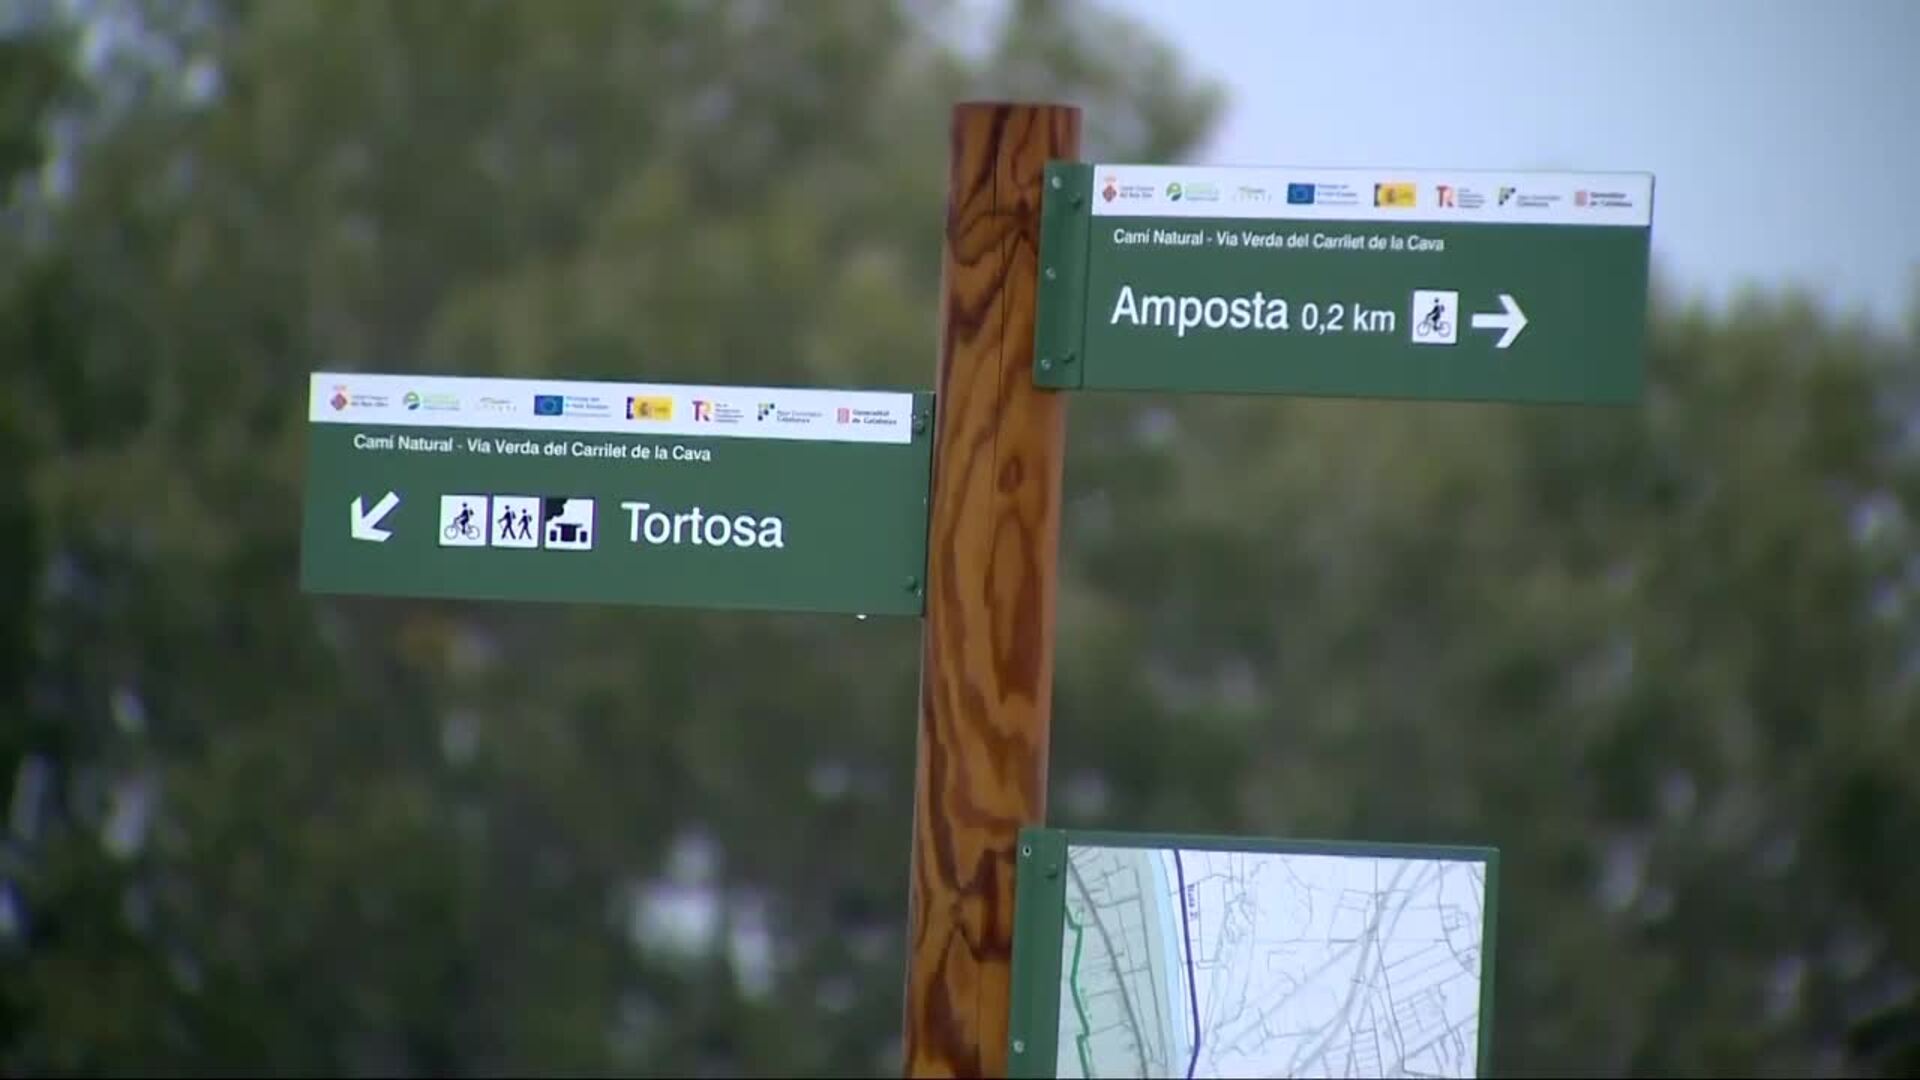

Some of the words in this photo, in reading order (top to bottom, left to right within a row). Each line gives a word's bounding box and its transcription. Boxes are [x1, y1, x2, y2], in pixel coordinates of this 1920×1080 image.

[1113, 228, 1150, 245] Camí
[1153, 229, 1204, 246] Natural
[1216, 230, 1239, 247] Via
[1241, 231, 1284, 248] Verda
[1286, 233, 1310, 249] del
[1311, 233, 1365, 250] Carrilet
[1367, 235, 1388, 250] de
[1390, 235, 1404, 250] la
[1406, 235, 1445, 251] Cava
[1110, 285, 1290, 338] Amposta
[1301, 302, 1345, 335] 0,2
[1352, 302, 1396, 332] km
[353, 433, 394, 450] Camí
[398, 435, 454, 452] Natural
[467, 438, 491, 454] Via
[494, 439, 540, 456] Verda
[543, 441, 567, 457] del
[571, 442, 627, 459] Carrilet
[630, 444, 650, 460] de
[654, 445, 668, 461] la
[672, 445, 711, 463] Cava
[620, 501, 785, 549] Tortosa
